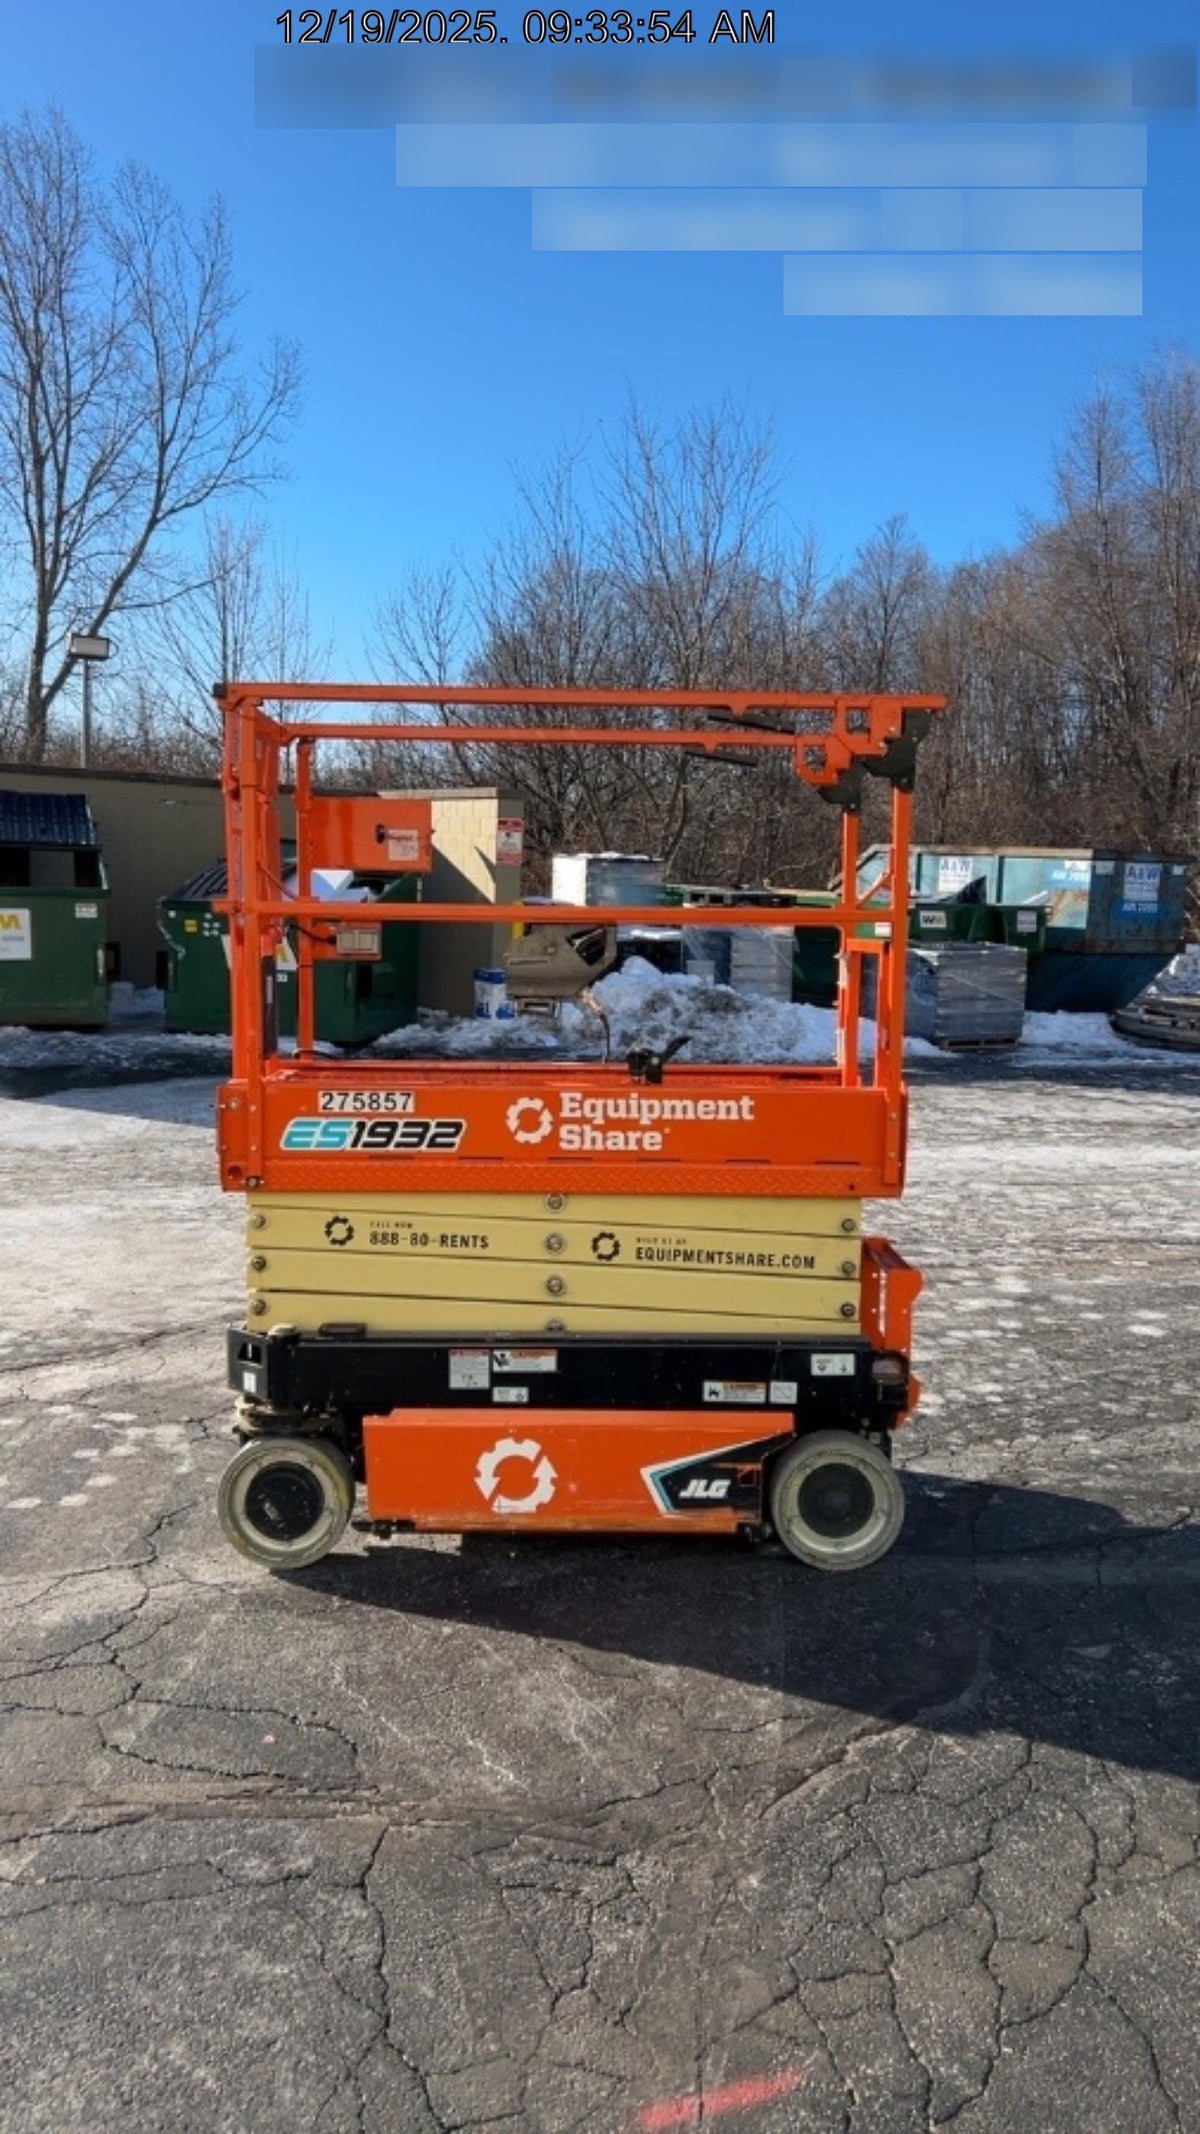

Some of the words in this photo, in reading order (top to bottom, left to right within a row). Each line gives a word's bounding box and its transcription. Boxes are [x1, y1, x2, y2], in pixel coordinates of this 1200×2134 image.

[321, 1091, 411, 1111] 275857
[560, 1091, 755, 1124] Equipment
[282, 1118, 466, 1150] ES1932
[560, 1124, 663, 1150] Share
[369, 1231, 489, 1249] 888-80-RENTS
[635, 1247, 815, 1269] EQUIPMENTSHARE.COM
[679, 1479, 731, 1499] JLG
